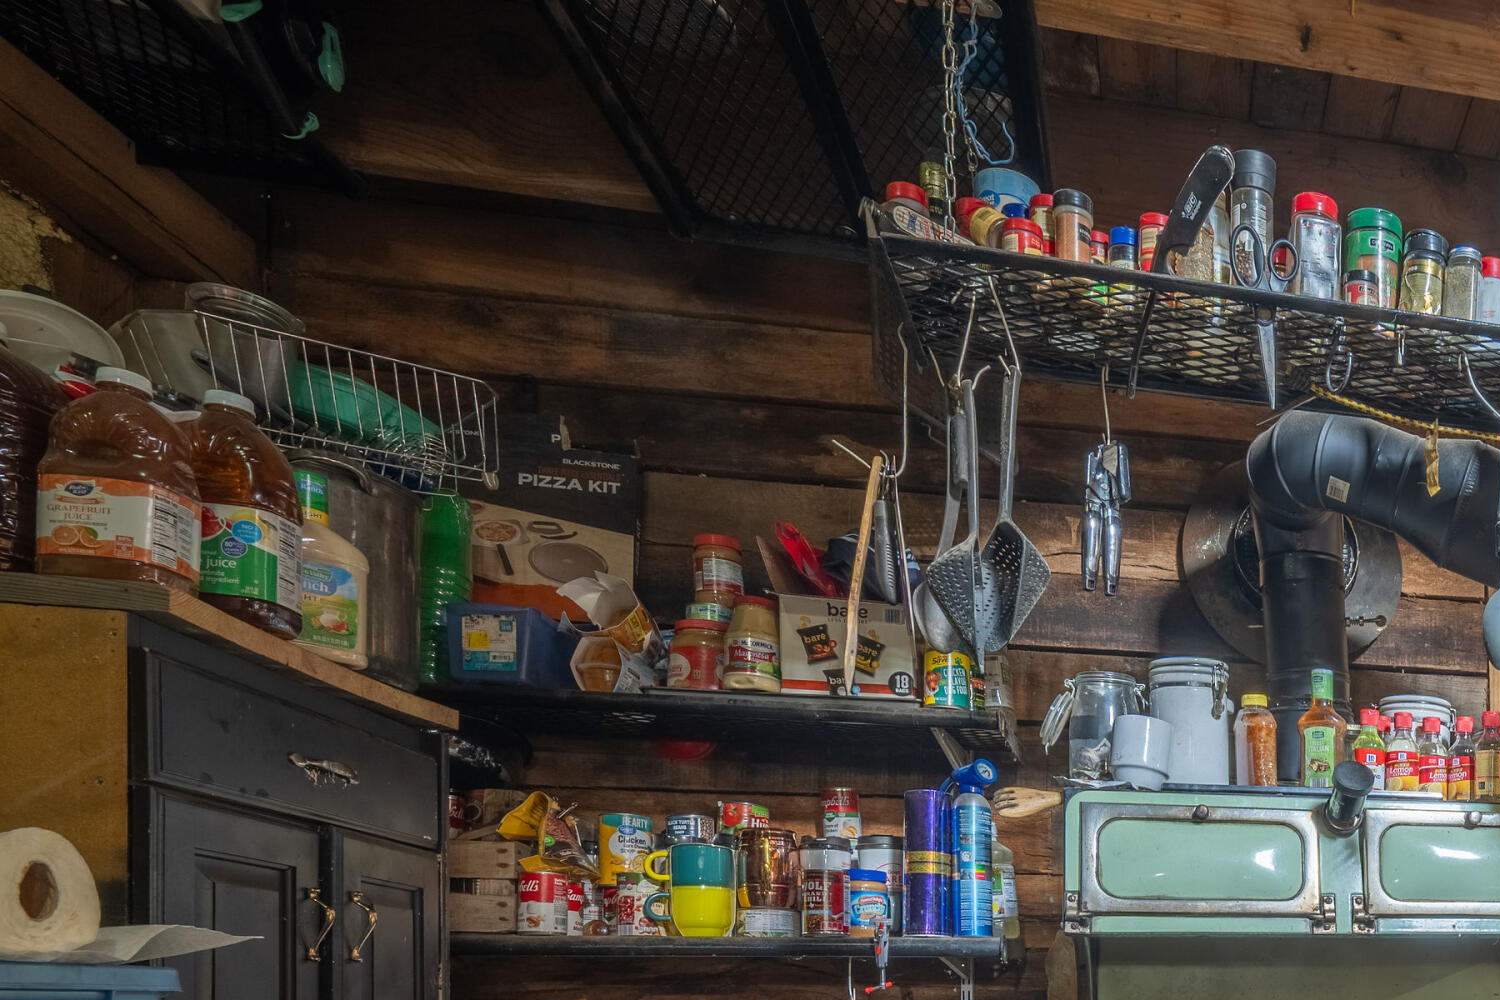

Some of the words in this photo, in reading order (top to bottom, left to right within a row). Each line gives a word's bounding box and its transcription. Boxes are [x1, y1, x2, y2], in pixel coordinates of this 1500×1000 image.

[562, 458, 622, 470] BLACKSTONE
[518, 473, 583, 491] PIZZA
[588, 479, 621, 494] KIT
[206, 556, 237, 569] juice
[827, 602, 868, 619] bae
[803, 633, 827, 644] bare
[894, 675, 910, 689] 18
[1389, 766, 1414, 774] Lemon
[622, 815, 648, 829] HEARTY
[618, 834, 646, 845] Chicken
